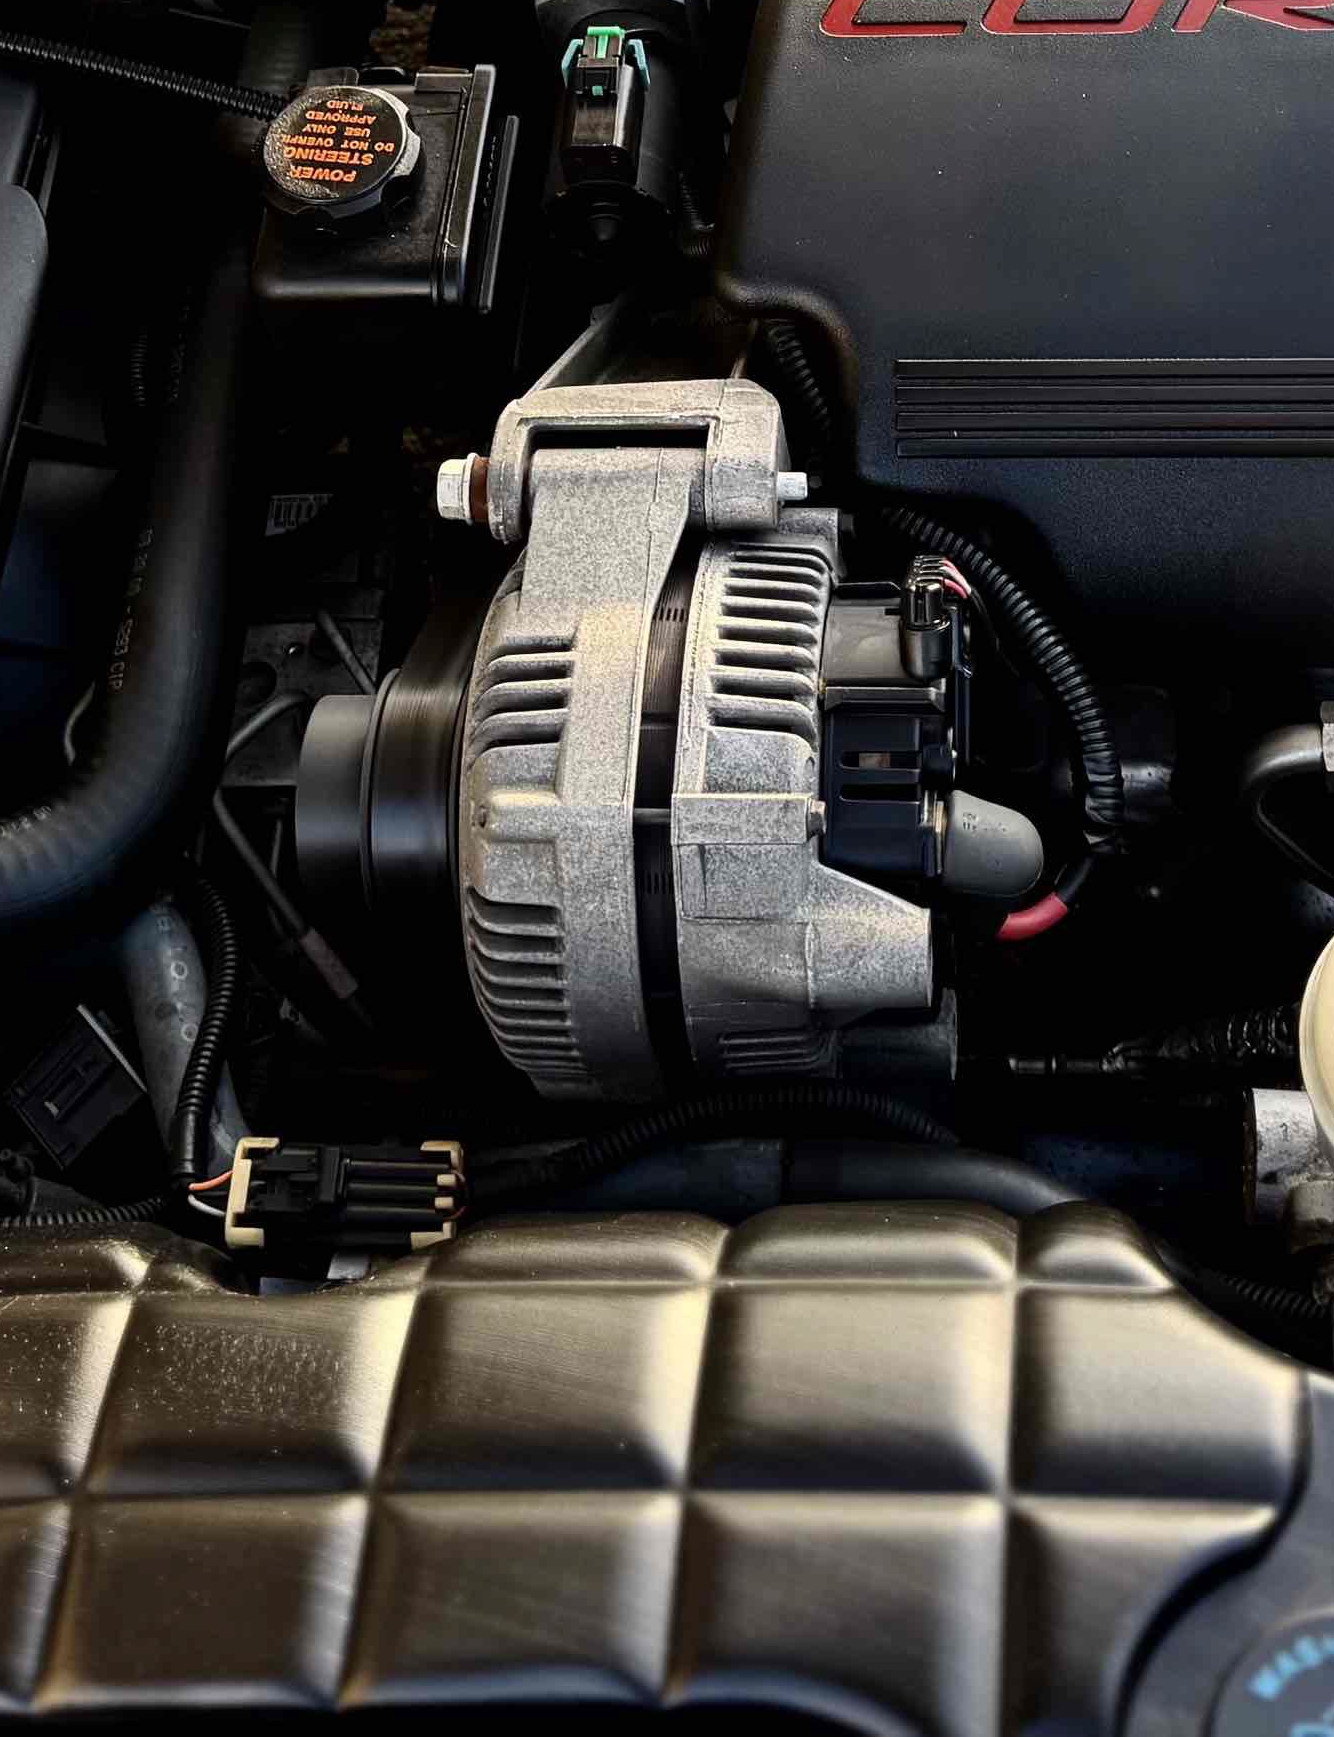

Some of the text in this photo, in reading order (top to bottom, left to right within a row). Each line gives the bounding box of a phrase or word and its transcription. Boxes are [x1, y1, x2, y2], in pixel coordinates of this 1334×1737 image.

[326, 100, 364, 111] FLUID
[305, 111, 377, 125] APPROVED
[301, 124, 370, 137] USE ONLY
[341, 140, 369, 151] NOT
[374, 142, 395, 153] DO
[283, 146, 375, 166] STEERING
[289, 165, 357, 183] POWER
